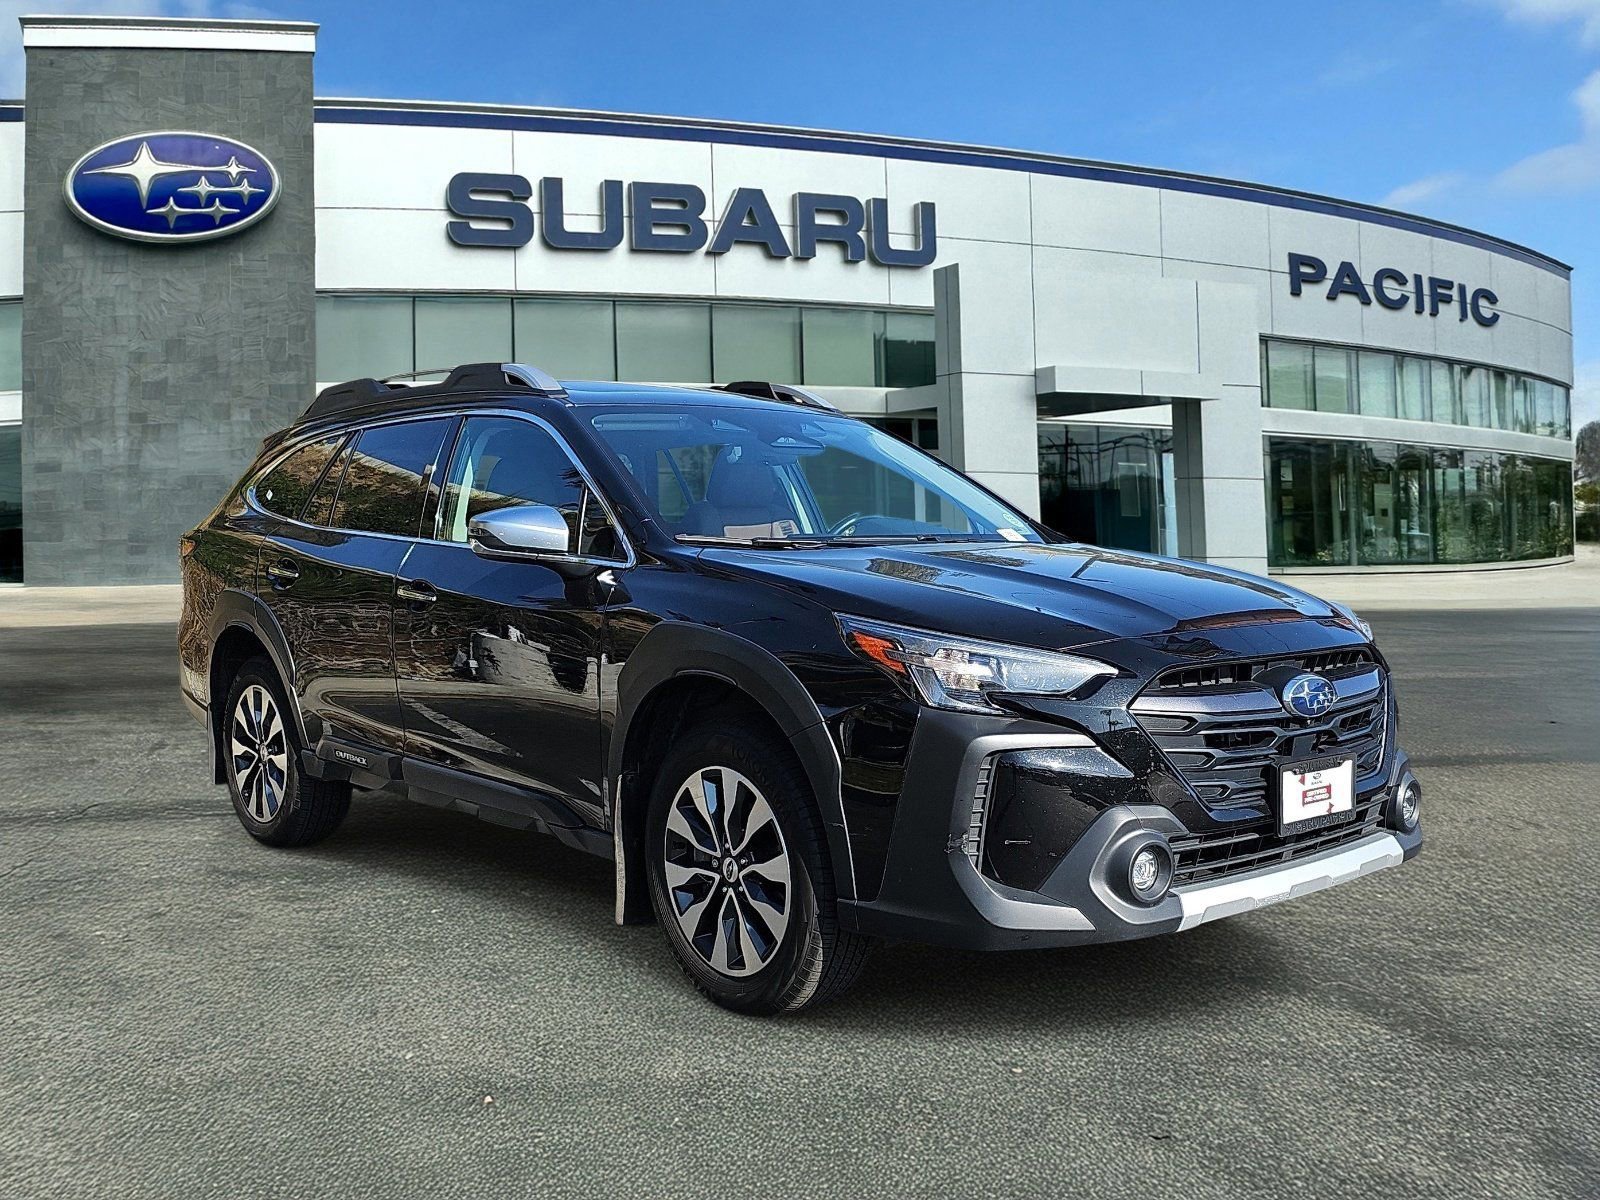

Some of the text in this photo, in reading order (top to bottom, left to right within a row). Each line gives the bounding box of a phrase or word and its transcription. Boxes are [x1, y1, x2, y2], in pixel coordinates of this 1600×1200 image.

[446, 172, 937, 268] SUBARU
[1288, 252, 1500, 327] PACIFIC
[335, 750, 367, 765] OUTBACK
